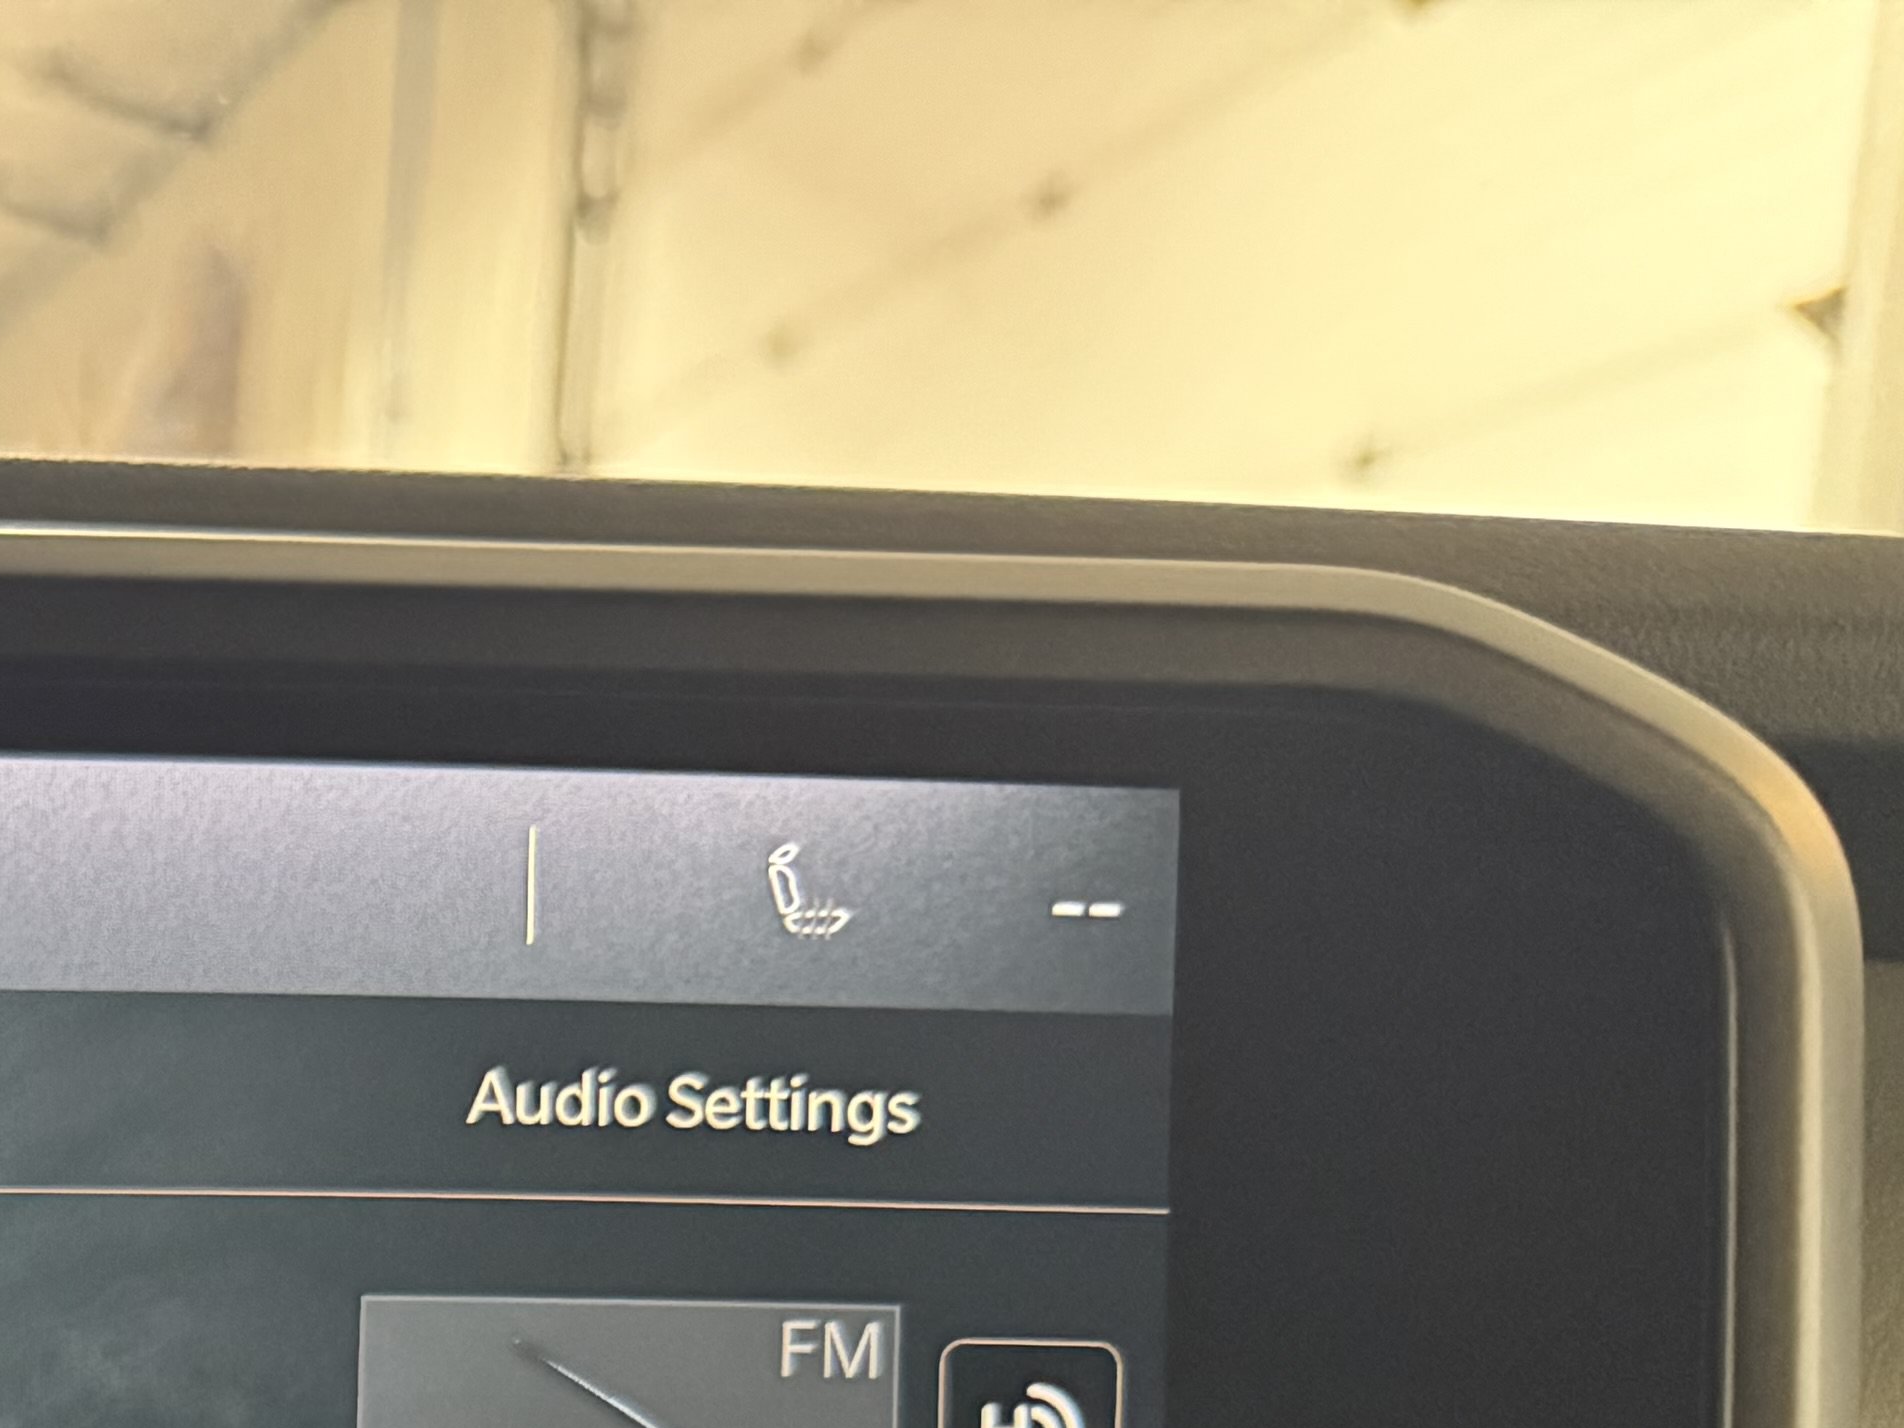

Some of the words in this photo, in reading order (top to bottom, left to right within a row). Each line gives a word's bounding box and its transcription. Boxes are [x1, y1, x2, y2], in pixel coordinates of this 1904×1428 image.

[464, 1065, 655, 1128] Audio
[664, 1072, 922, 1147] Settings
[780, 1320, 882, 1380] FM
